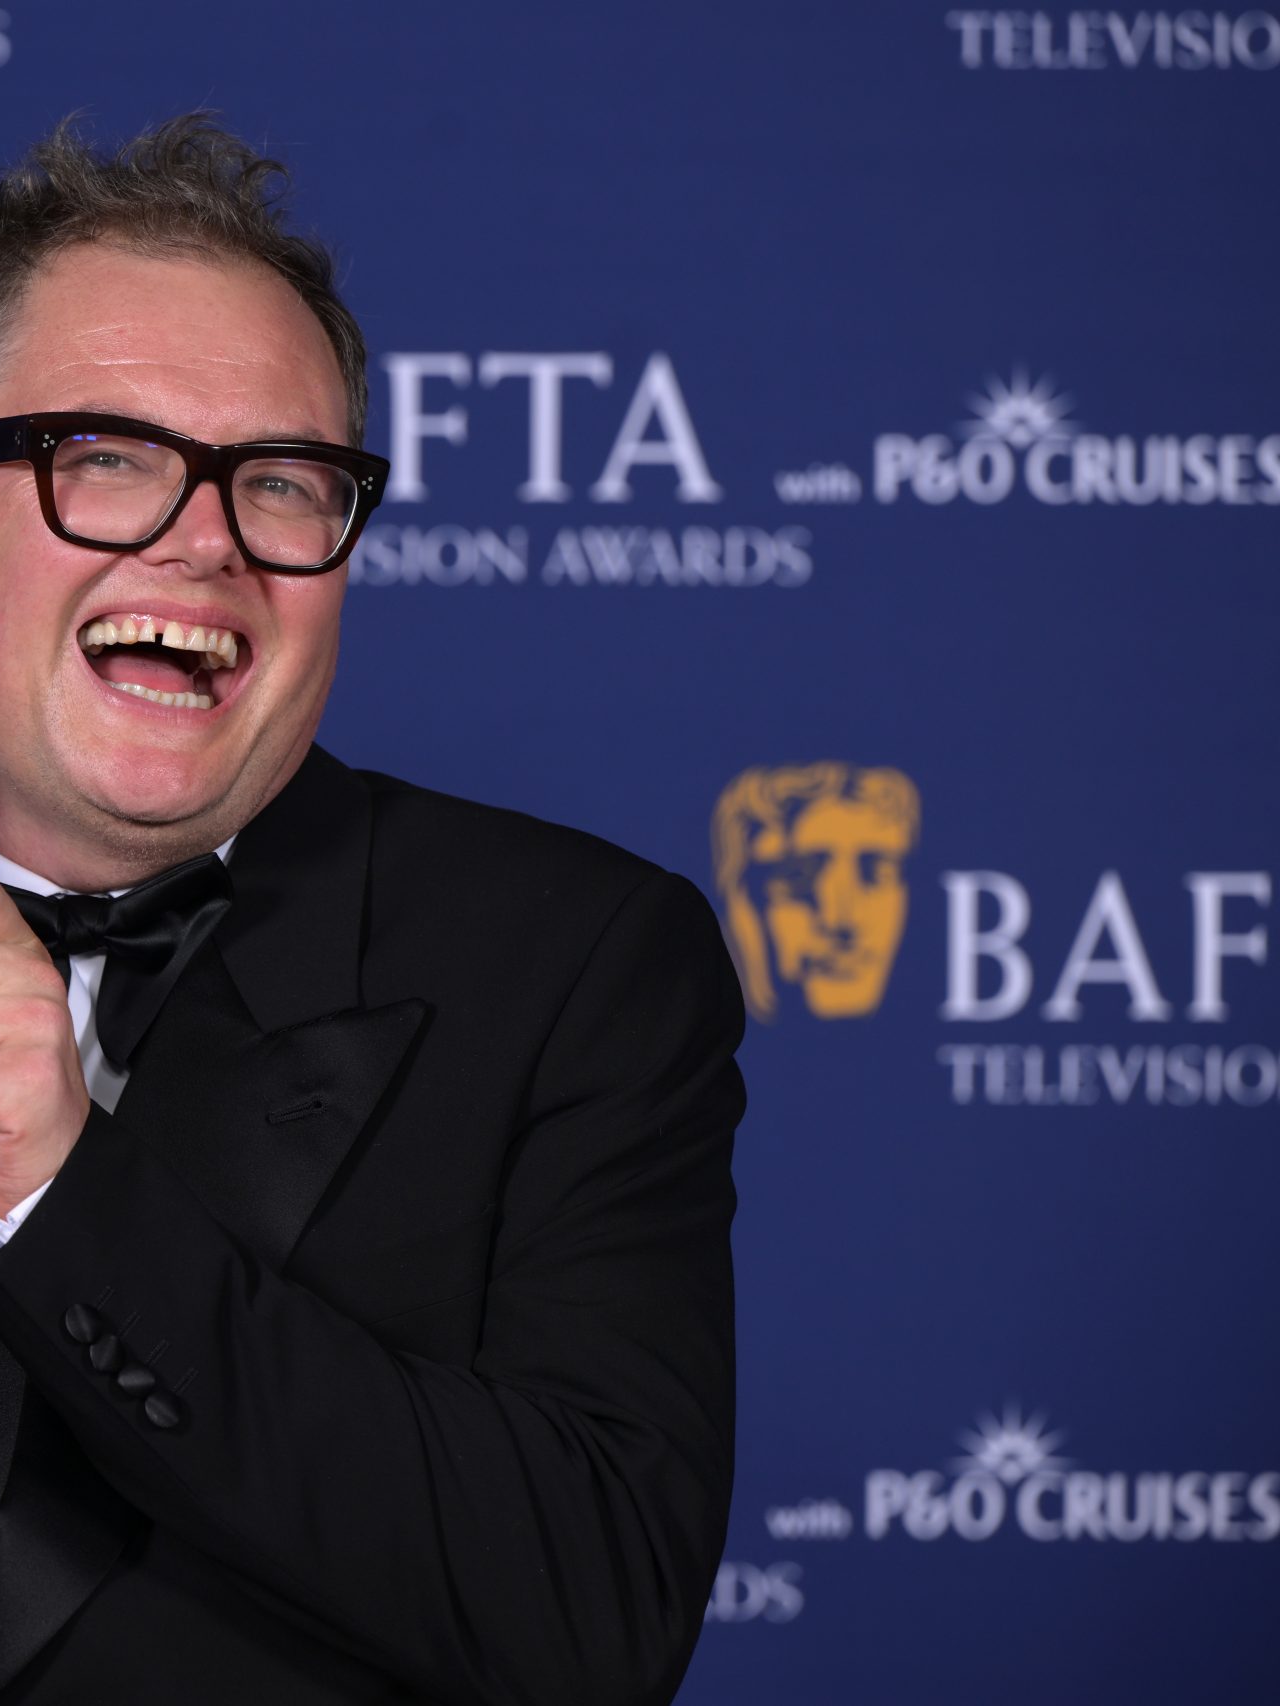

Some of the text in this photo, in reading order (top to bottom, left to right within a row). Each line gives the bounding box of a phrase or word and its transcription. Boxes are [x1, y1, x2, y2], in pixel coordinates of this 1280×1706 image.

[947, 11, 1280, 69] TELEVISIO
[382, 351, 723, 504] FTA
[774, 433, 1280, 504] with P&O CRUISES
[543, 526, 812, 586] AWARDS
[940, 870, 1272, 1022] BAF
[938, 1044, 1280, 1104] TELEVISIO
[766, 1469, 1280, 1541] with P&O CRUISES
